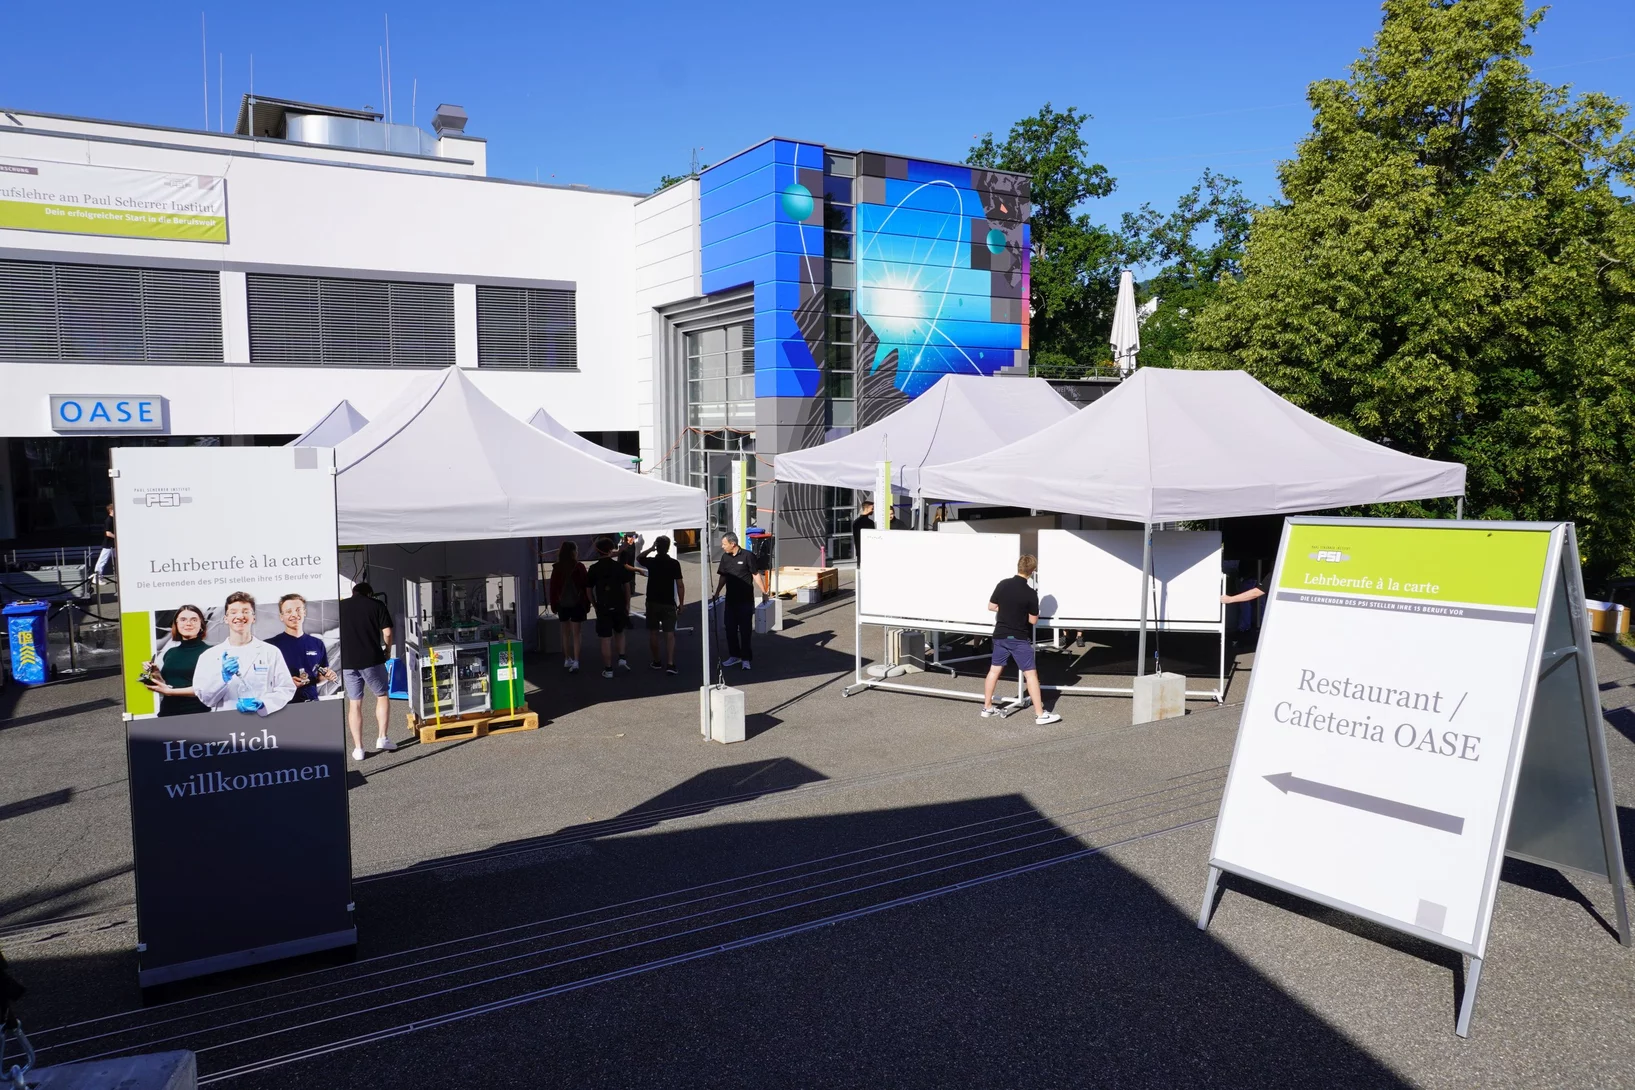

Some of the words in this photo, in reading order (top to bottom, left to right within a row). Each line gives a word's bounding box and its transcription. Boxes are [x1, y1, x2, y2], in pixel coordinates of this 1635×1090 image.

[60, 194, 79, 203] am
[83, 194, 111, 205] Paul
[115, 197, 167, 210] Scherrer
[172, 201, 214, 213] Institut
[45, 208, 65, 216] Dein
[67, 210, 123, 220] erfolgreicher
[125, 213, 146, 222] Start
[173, 217, 216, 226] Berufswelt
[60, 401, 153, 422] OASE
[146, 493, 180, 507] PSI
[150, 556, 244, 573] Lehrberufe
[249, 556, 258, 568] à
[263, 555, 277, 567] la
[282, 555, 322, 567] carte
[1316, 550, 1343, 563] PSI
[137, 581, 150, 589] Die
[152, 579, 196, 588] Lernenden
[198, 578, 212, 586] des
[214, 577, 227, 585] PSI
[229, 576, 256, 584] stellen
[284, 573, 308, 581] Berufe
[1304, 573, 1373, 589] Lehrberufe
[1376, 578, 1384, 590] à
[1388, 578, 1400, 591] la
[1404, 582, 1440, 594] carte
[1310, 596, 1343, 605] LERNENDEN
[1369, 601, 1396, 610] STELLEN
[1422, 606, 1448, 614] BERUFE
[1449, 608, 1464, 616] VOR
[1297, 668, 1443, 713] Restaurant
[1449, 691, 1468, 722] /
[1274, 701, 1384, 743] Cafeteria
[1394, 723, 1481, 761] OASE
[163, 729, 279, 762] Herzlich
[164, 763, 330, 798] willkommen
